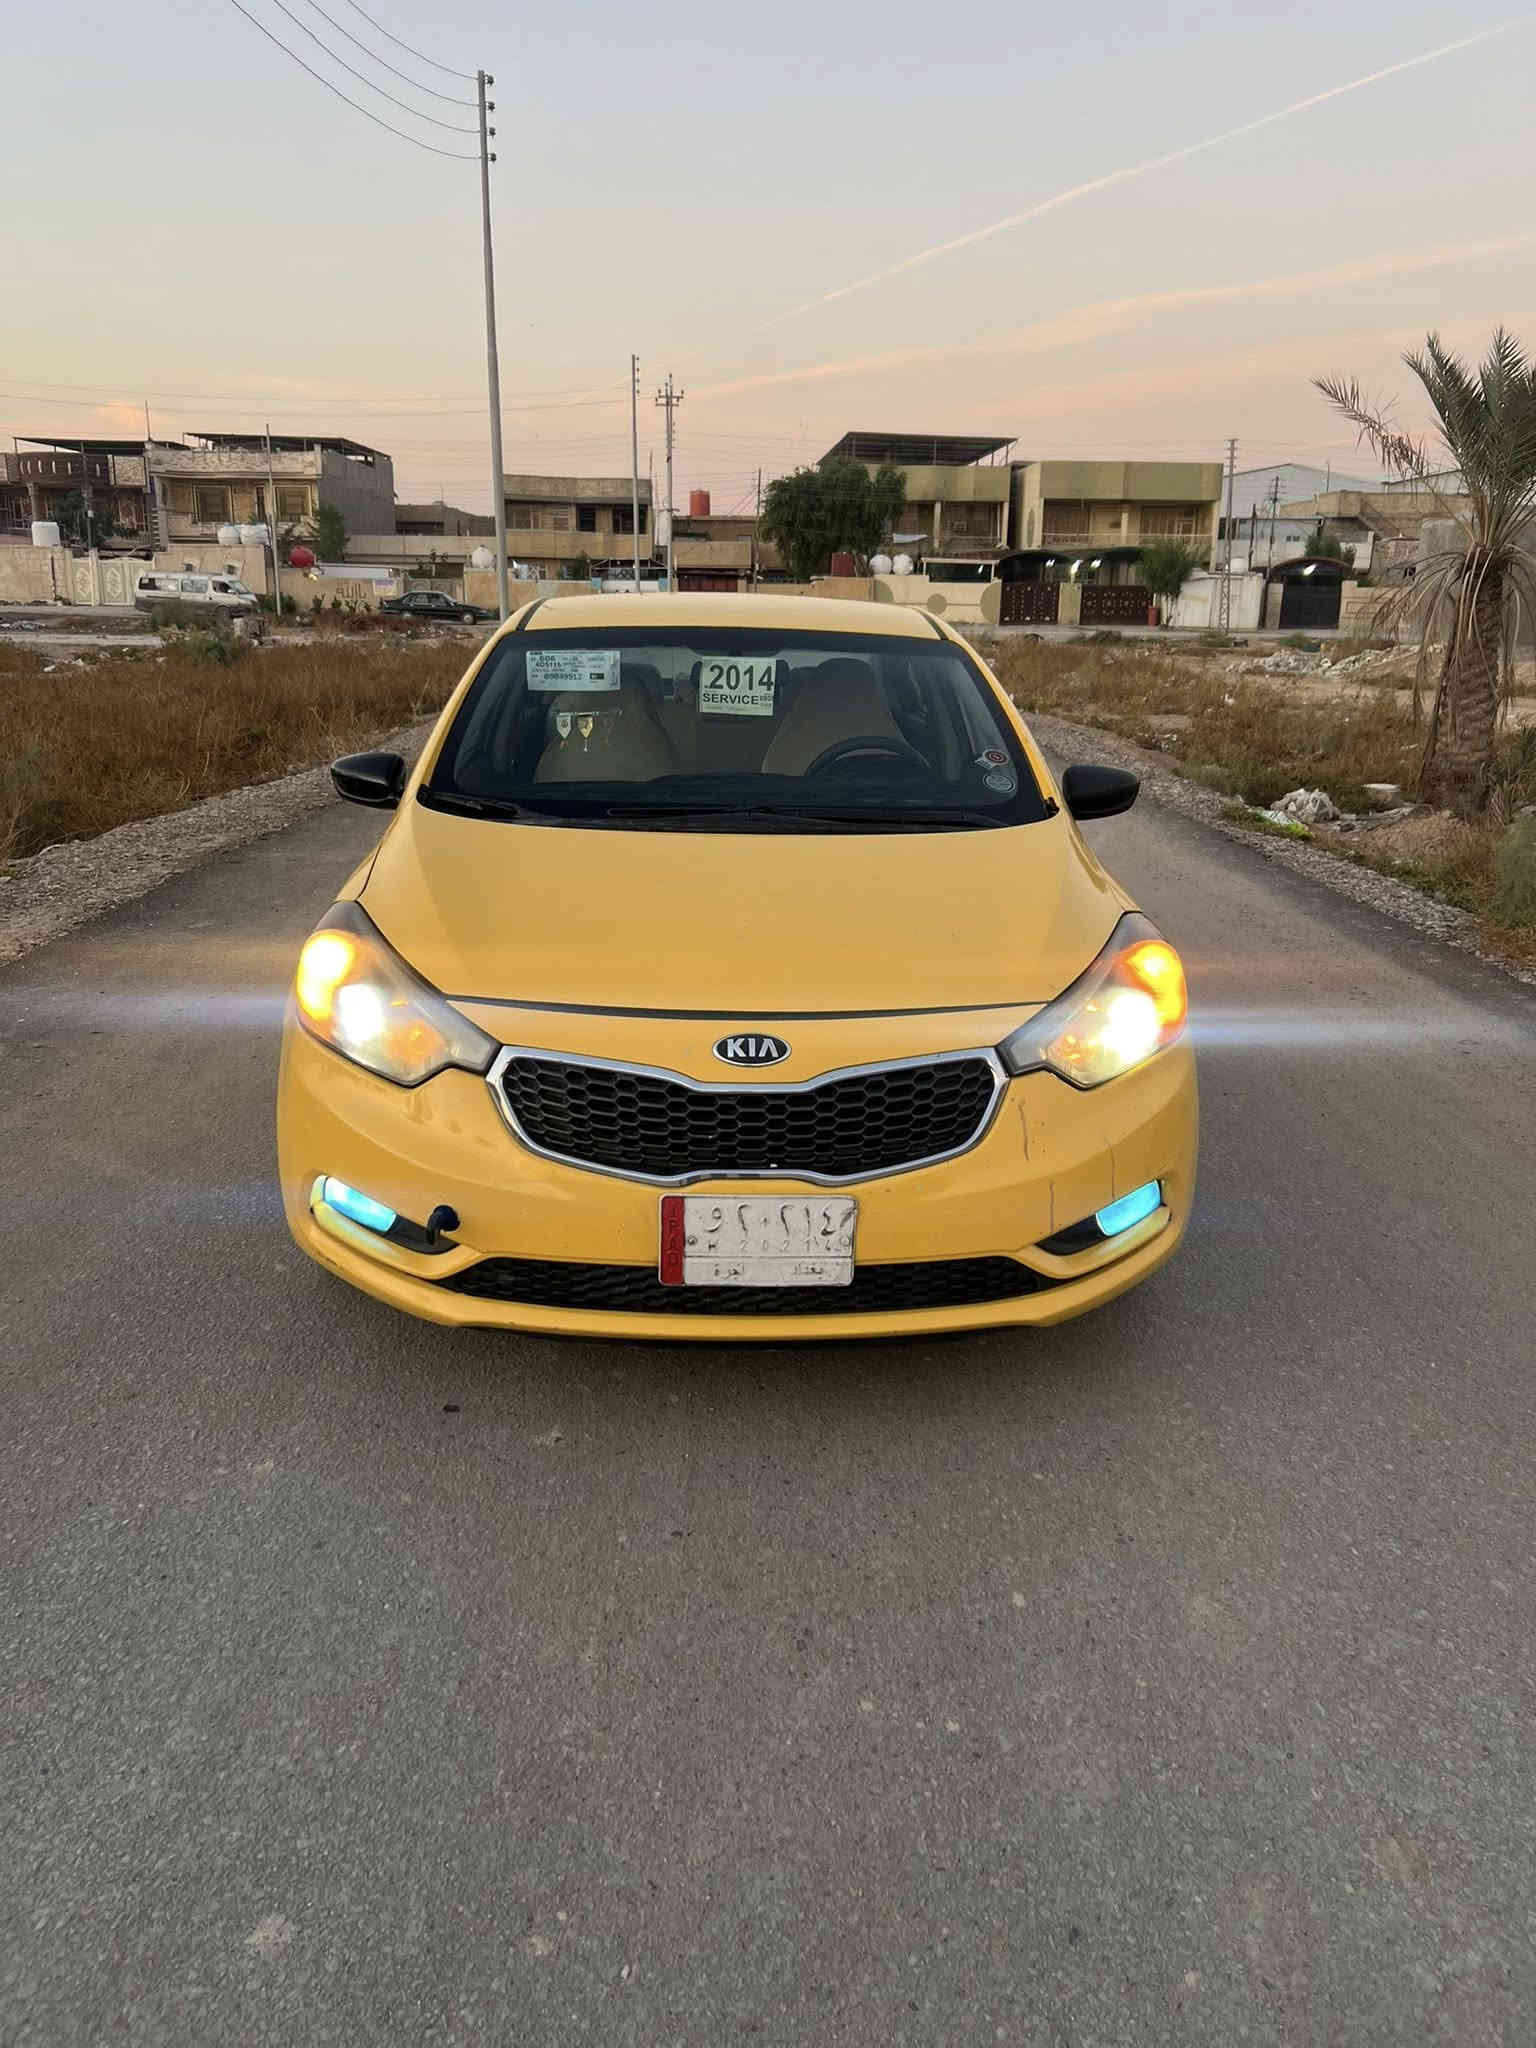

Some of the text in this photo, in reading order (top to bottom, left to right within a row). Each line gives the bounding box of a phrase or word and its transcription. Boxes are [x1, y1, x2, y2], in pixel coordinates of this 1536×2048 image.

[709, 664, 774, 691] 2014
[702, 692, 759, 705] SERVICE
[727, 1037, 779, 1058] KIA
